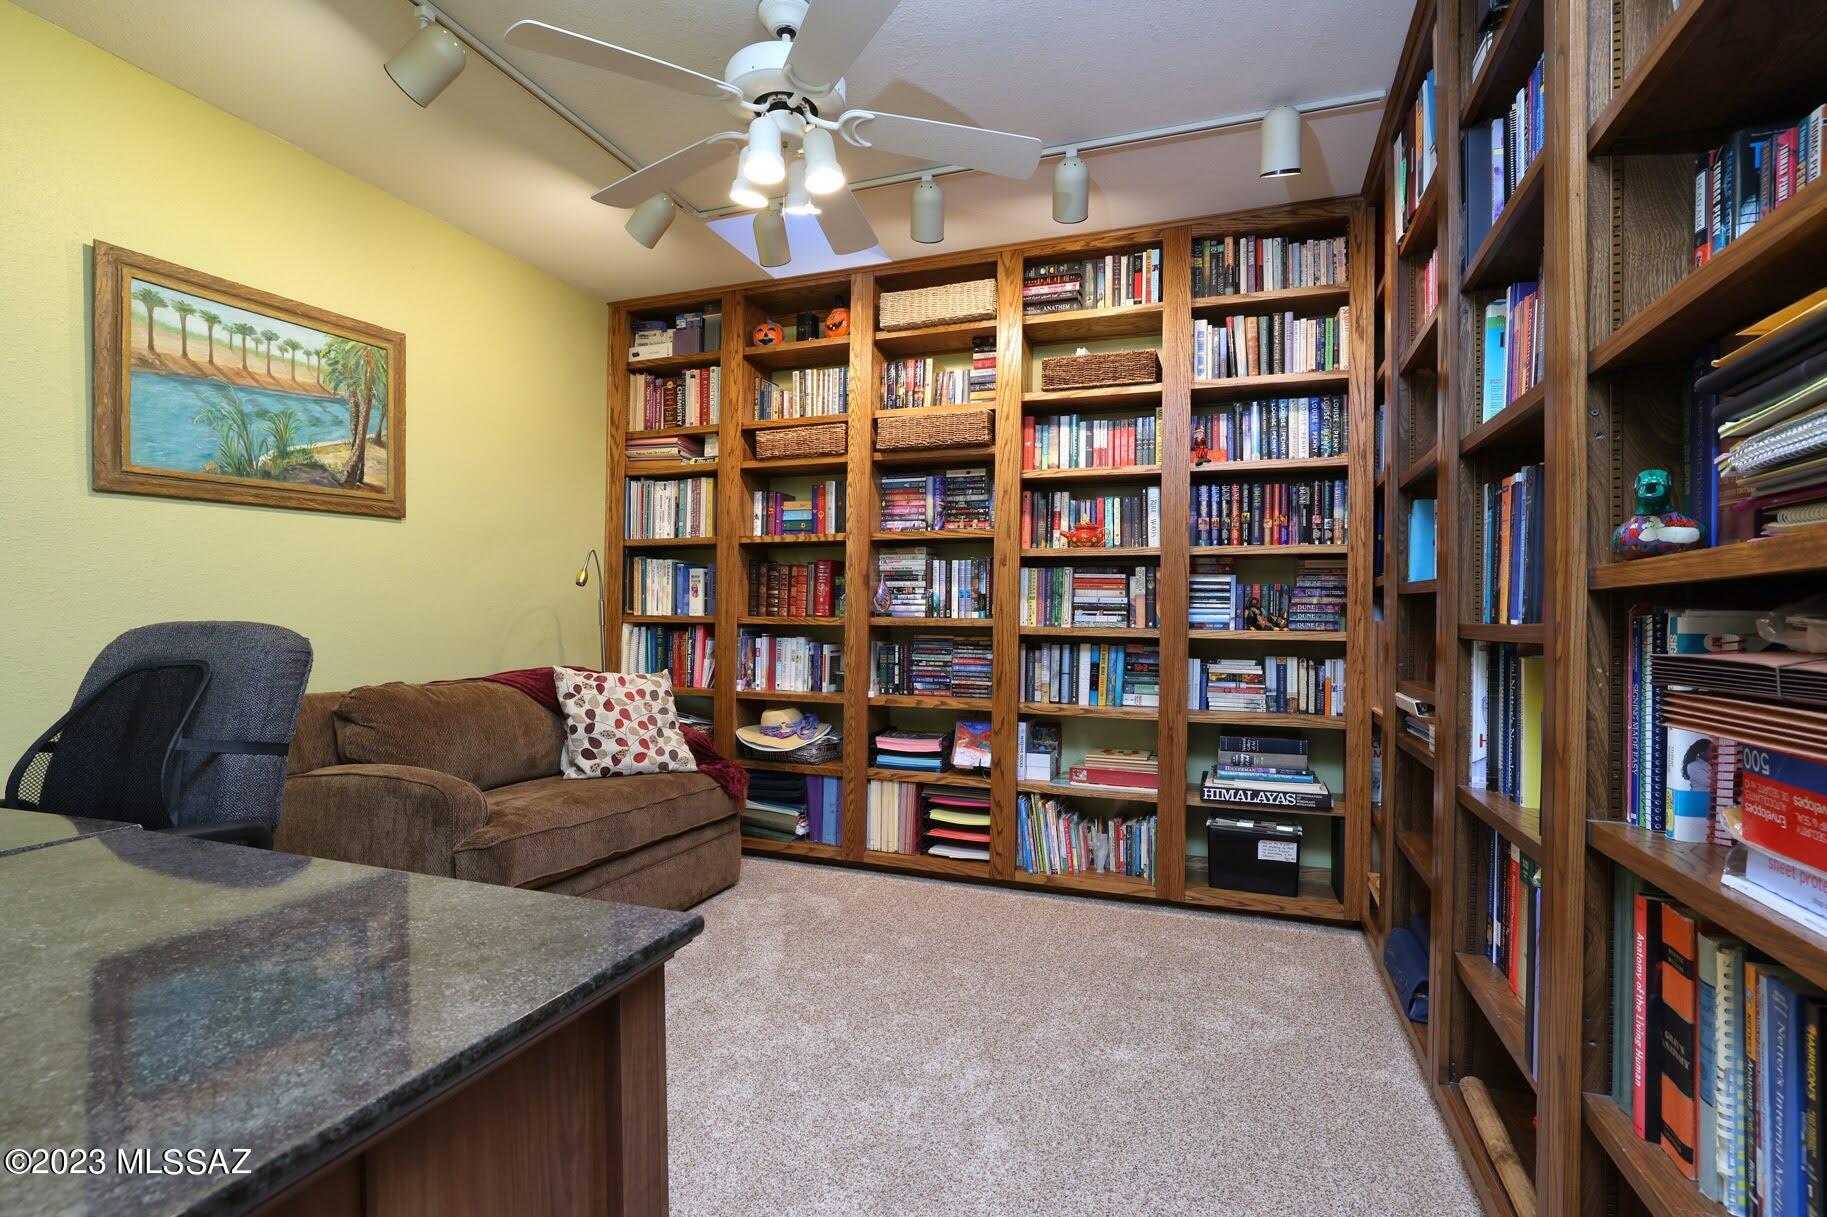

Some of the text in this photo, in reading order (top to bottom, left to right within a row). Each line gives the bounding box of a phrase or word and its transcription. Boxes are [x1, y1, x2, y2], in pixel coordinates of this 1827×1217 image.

[1811, 116, 1820, 158] THOMAS
[1778, 143, 1790, 201] THOMAS PERRY
[1712, 161, 1722, 237] THOMAS PERRY
[1298, 486, 1306, 504] DUNE
[1631, 683, 1639, 721] SIGNING
[1631, 750, 1639, 775] EASY
[1743, 747, 1770, 775] 500
[1203, 788, 1297, 806] HIMALAYAS
[1744, 803, 1787, 829] Enveloppes
[1793, 795, 1827, 815] velopes
[1767, 857, 1797, 880] sheet
[1633, 932, 1645, 1088] Anatomy of the Living Human
[1776, 1022, 1786, 1085] Netter's
[1807, 1032, 1817, 1101] HARRISON'S
[1774, 1091, 1784, 1160] Internal
